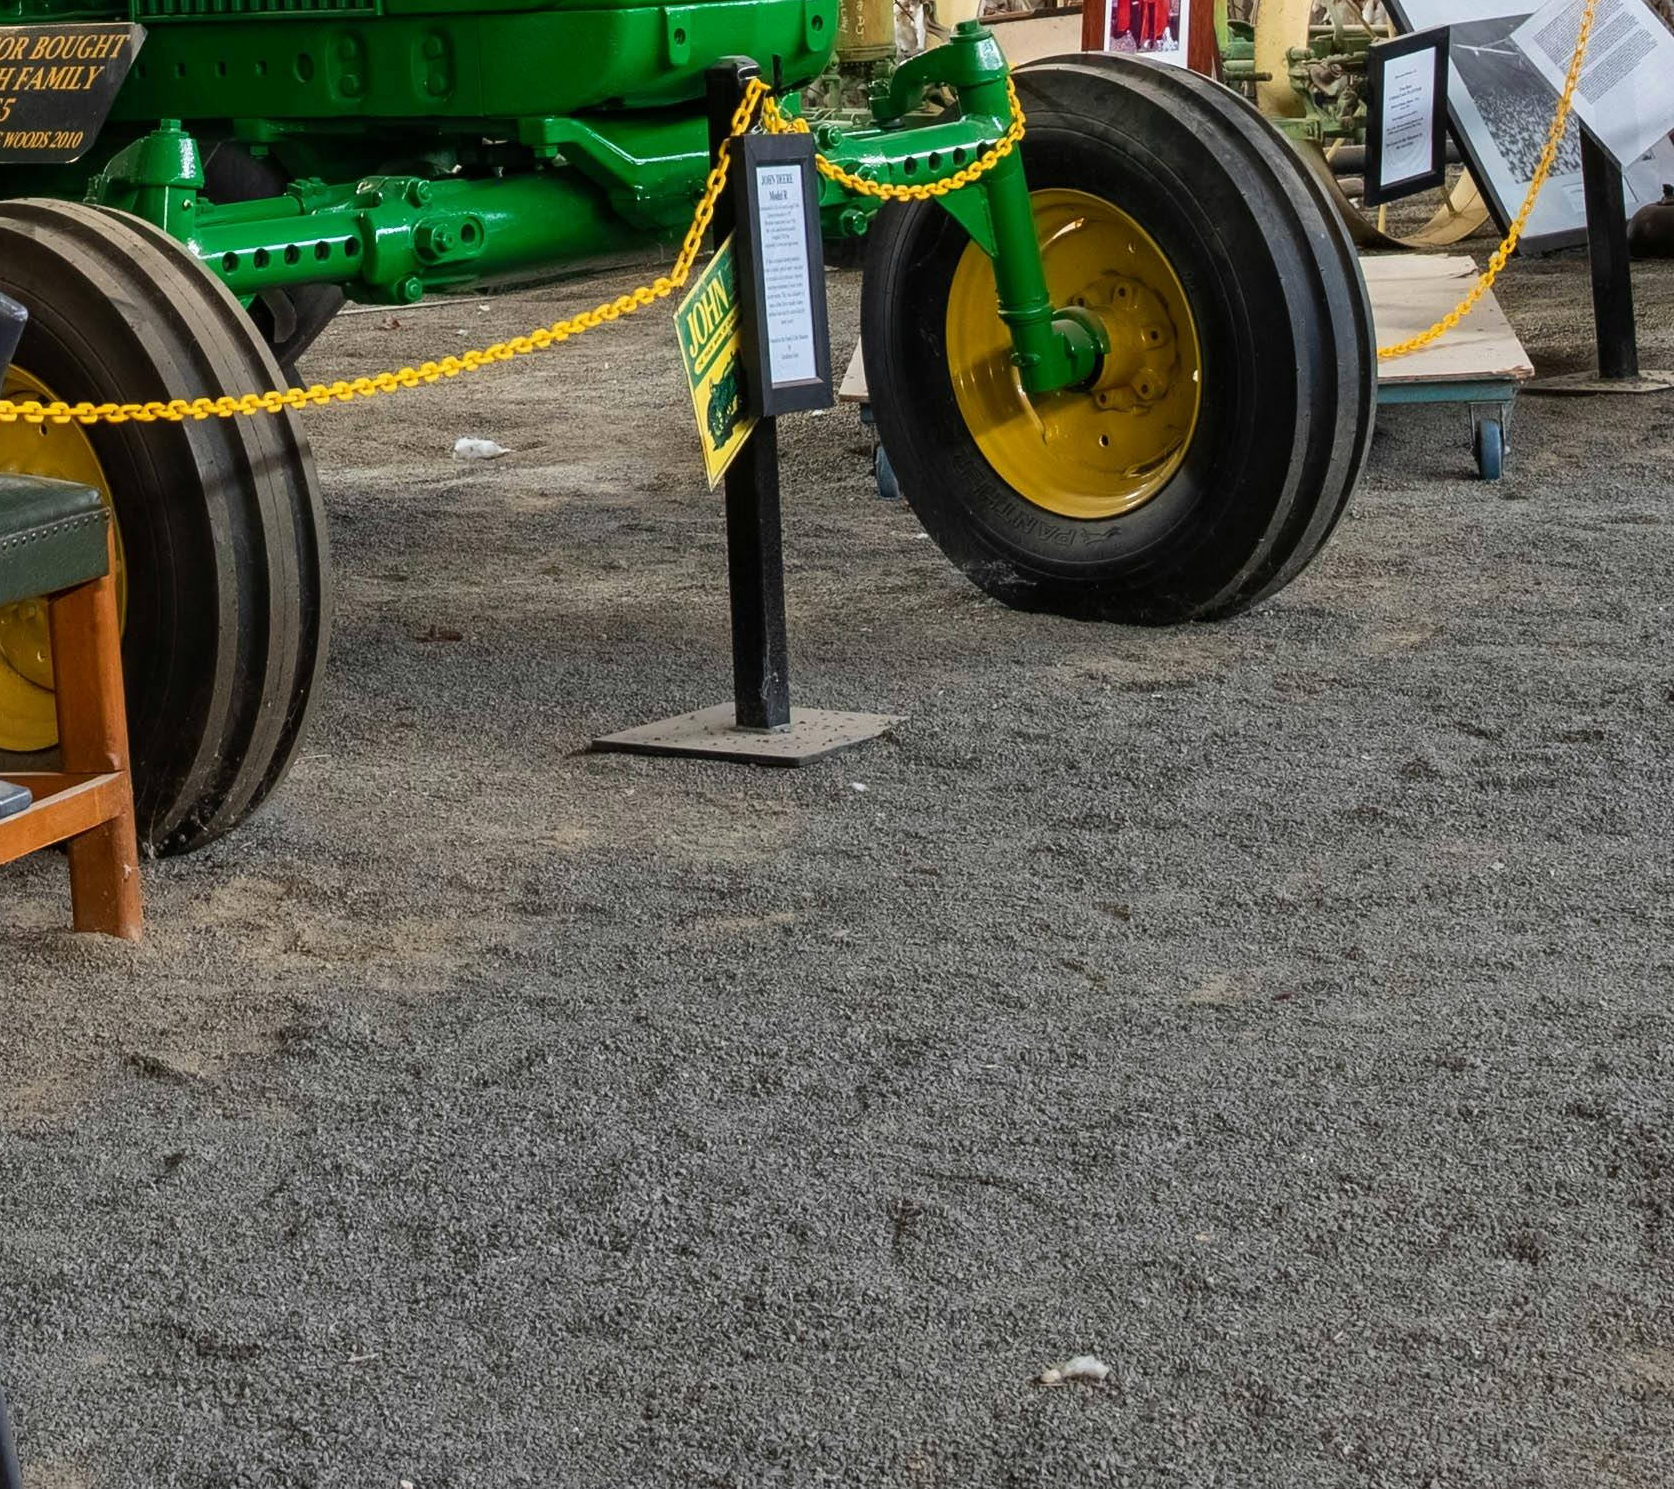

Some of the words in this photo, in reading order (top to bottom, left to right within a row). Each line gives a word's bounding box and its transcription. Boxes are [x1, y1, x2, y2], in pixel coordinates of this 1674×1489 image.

[29, 33, 132, 60] BOUGHT
[12, 65, 106, 91] FAMILY
[3, 130, 54, 149] WOODS
[48, 130, 85, 149] 2010
[686, 269, 730, 359] JOHN
